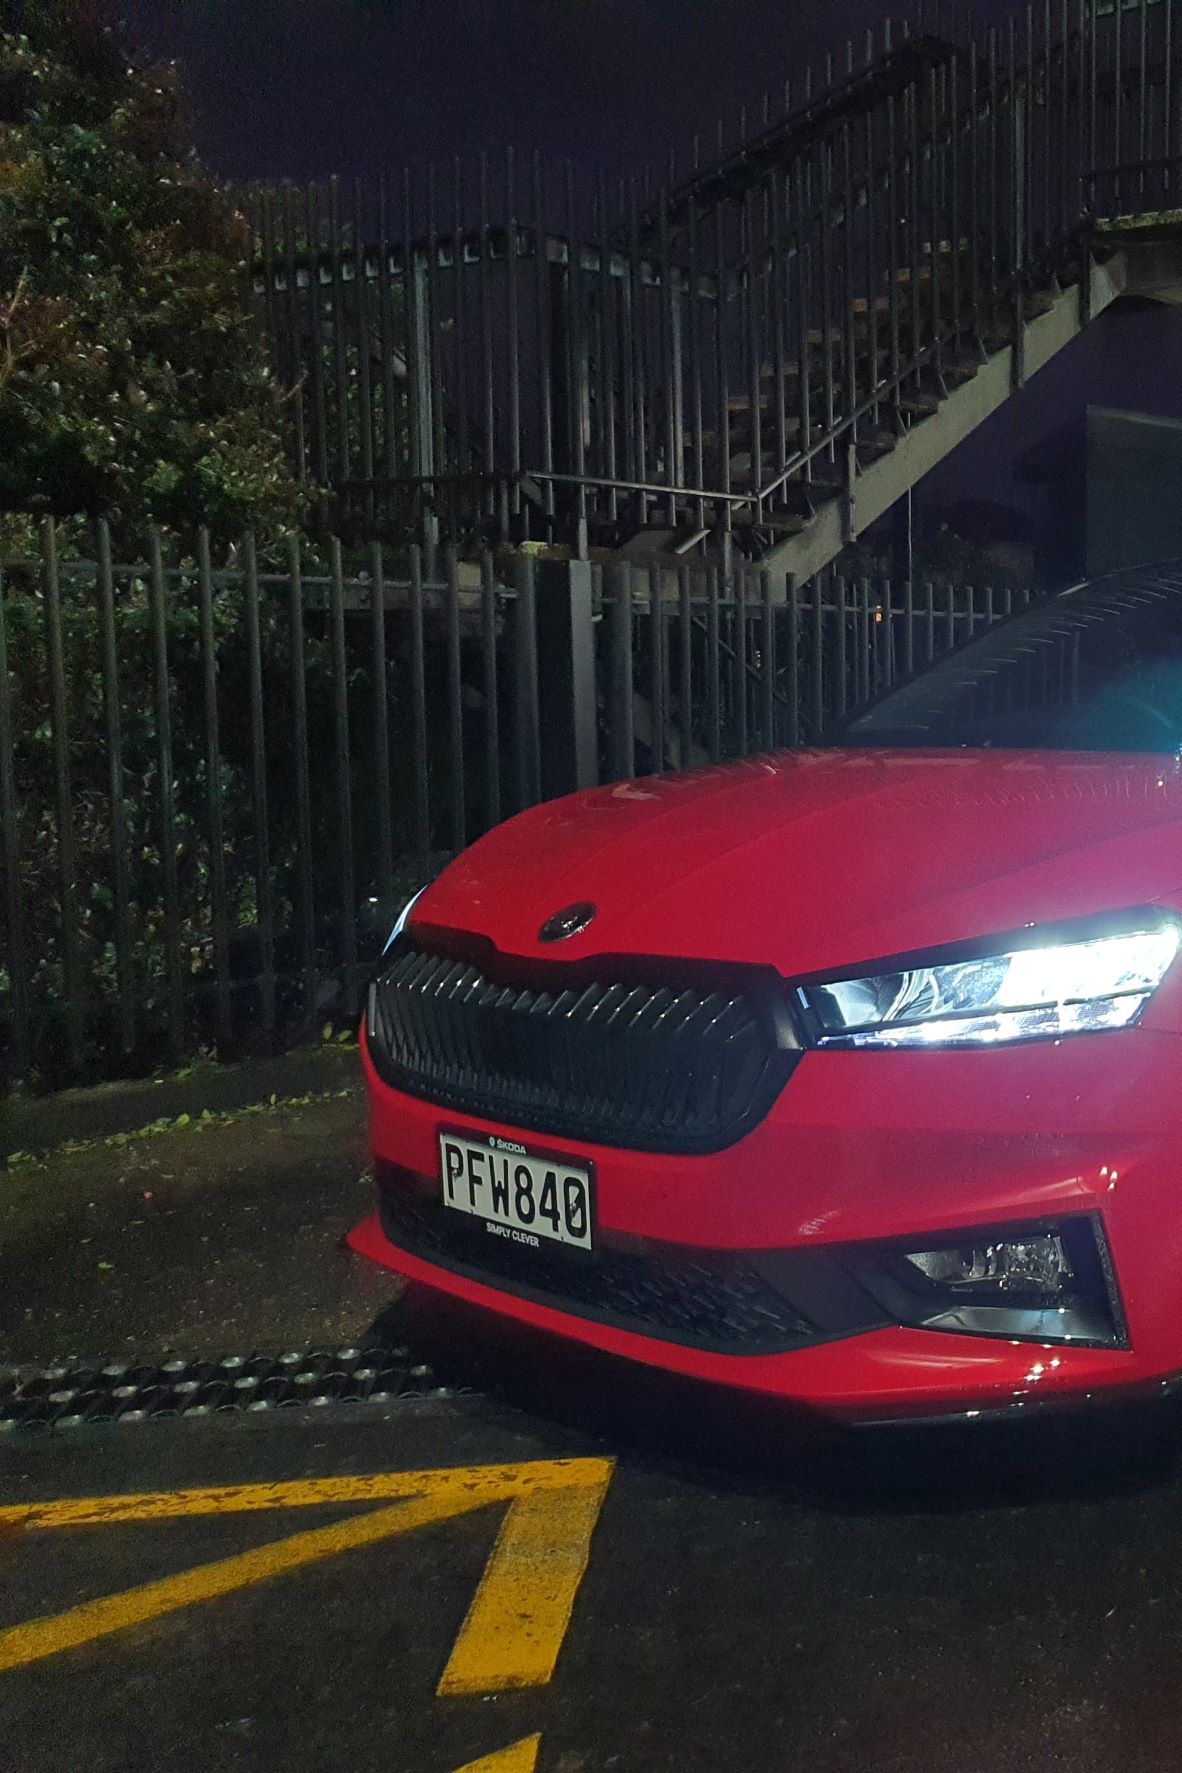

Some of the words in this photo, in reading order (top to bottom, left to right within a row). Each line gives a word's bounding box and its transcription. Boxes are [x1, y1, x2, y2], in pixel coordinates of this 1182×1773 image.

[445, 1143, 588, 1239] PFW840
[486, 1222, 511, 1239] SIMPLY
[512, 1230, 540, 1247] CLEVER
